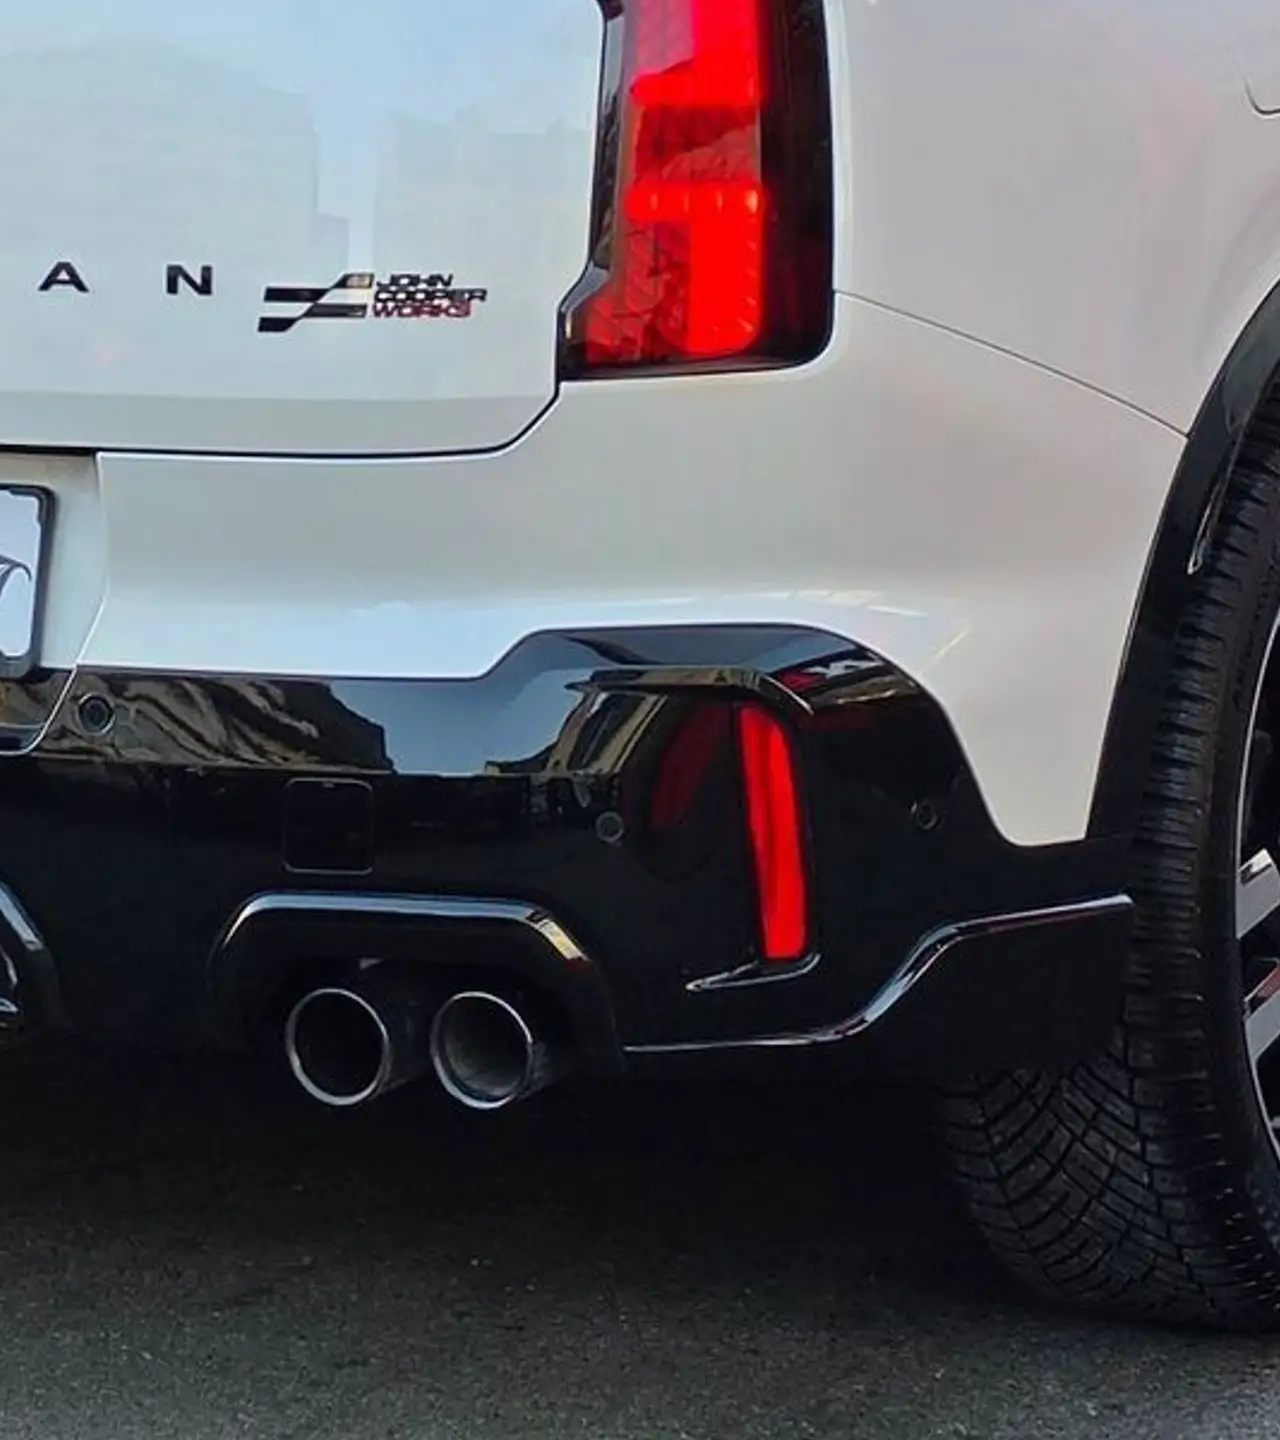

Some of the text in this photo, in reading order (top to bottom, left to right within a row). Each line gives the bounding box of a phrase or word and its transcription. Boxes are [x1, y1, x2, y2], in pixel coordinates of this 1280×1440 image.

[377, 273, 453, 287] JOHN
[373, 287, 488, 302] COOPER
[372, 300, 472, 318] WORKS
